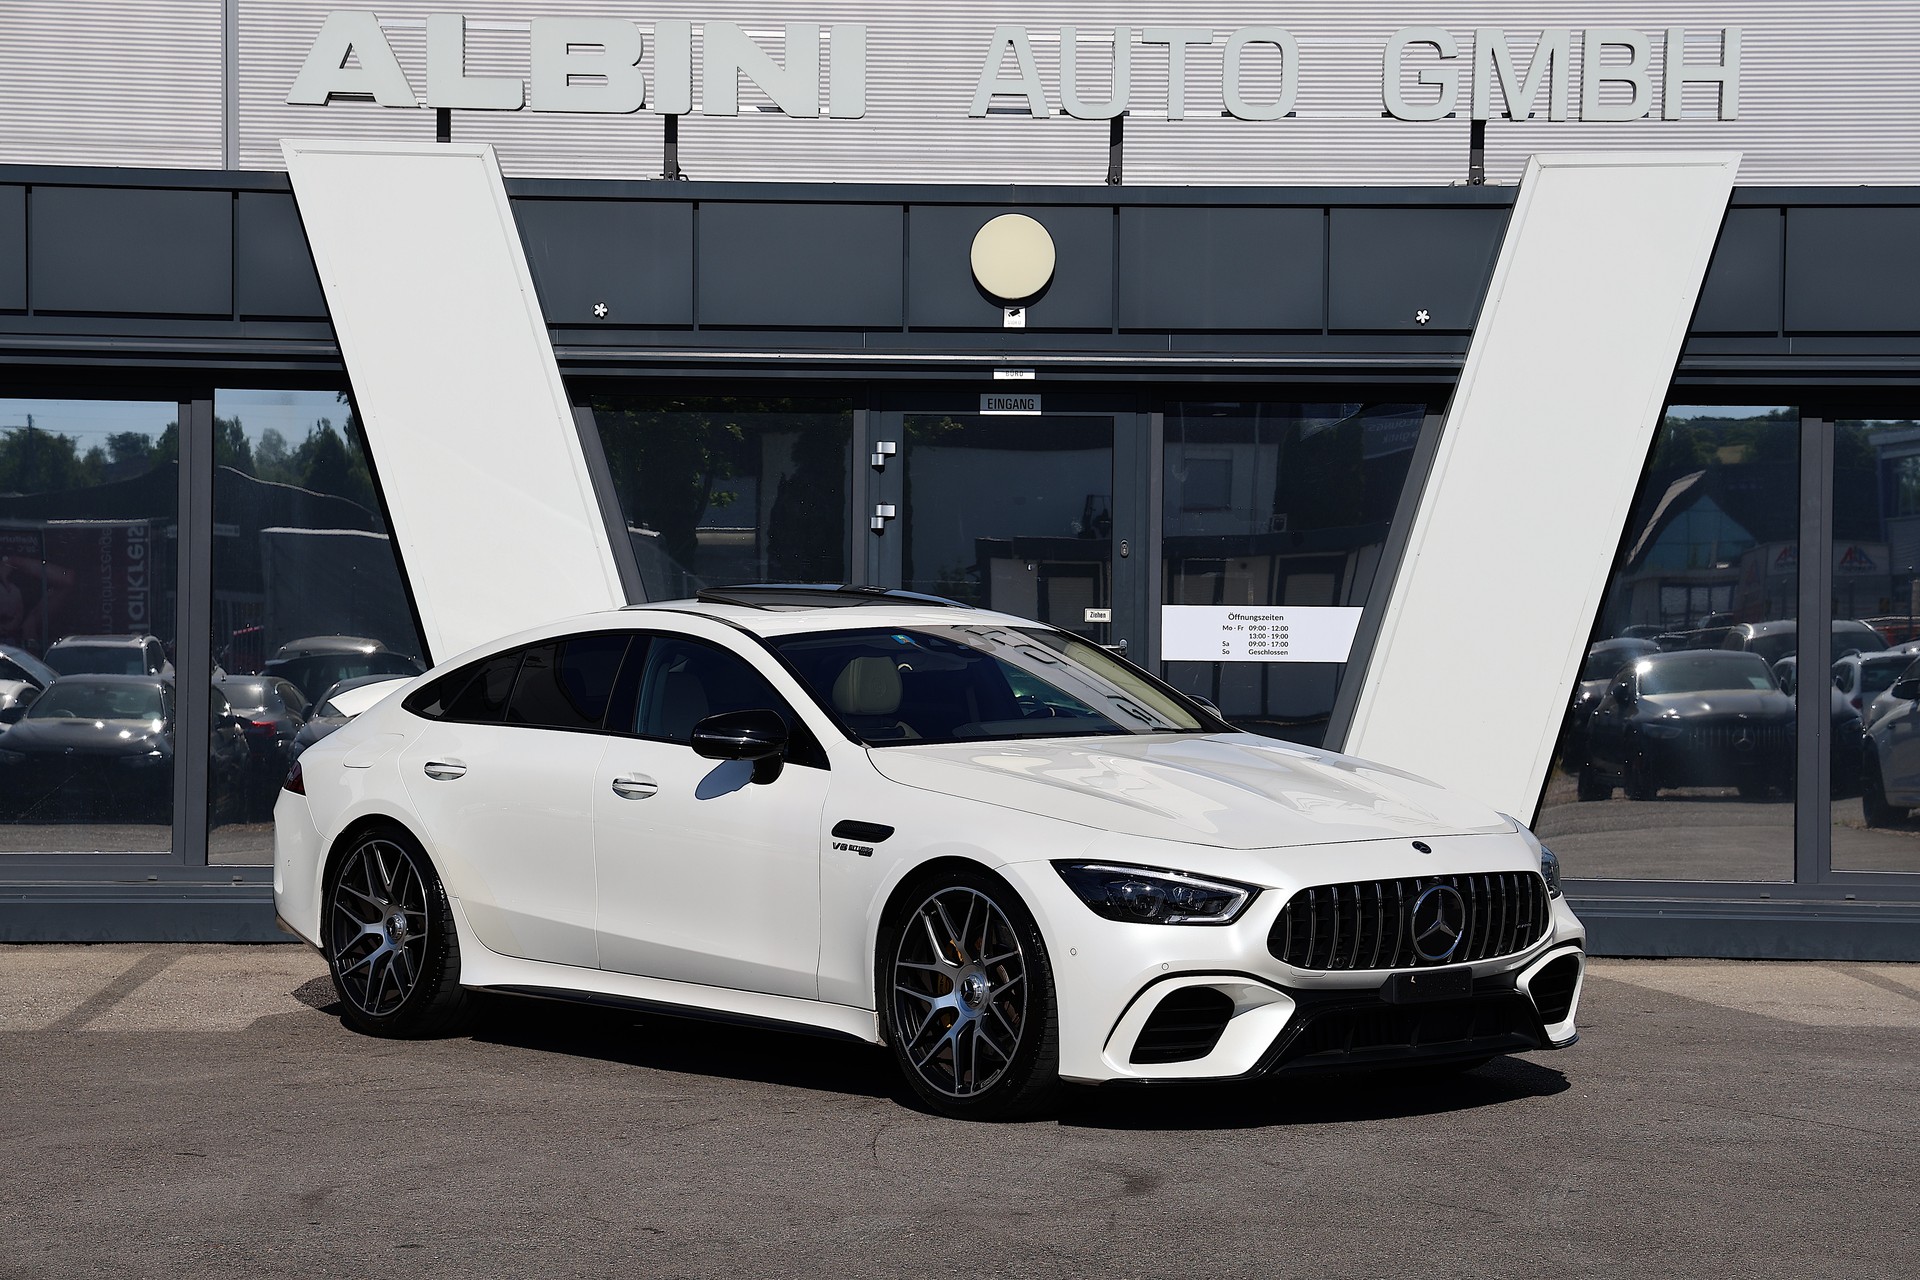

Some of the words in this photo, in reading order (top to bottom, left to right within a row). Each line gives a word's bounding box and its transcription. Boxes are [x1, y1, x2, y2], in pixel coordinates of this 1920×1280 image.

[286, 10, 867, 119] ALBINI
[968, 26, 1300, 121] AUTO
[1382, 27, 1743, 122] GMBH
[987, 399, 1034, 410] EINGANG
[1228, 612, 1284, 622] Öffnungszeiten
[832, 841, 848, 851] V8
